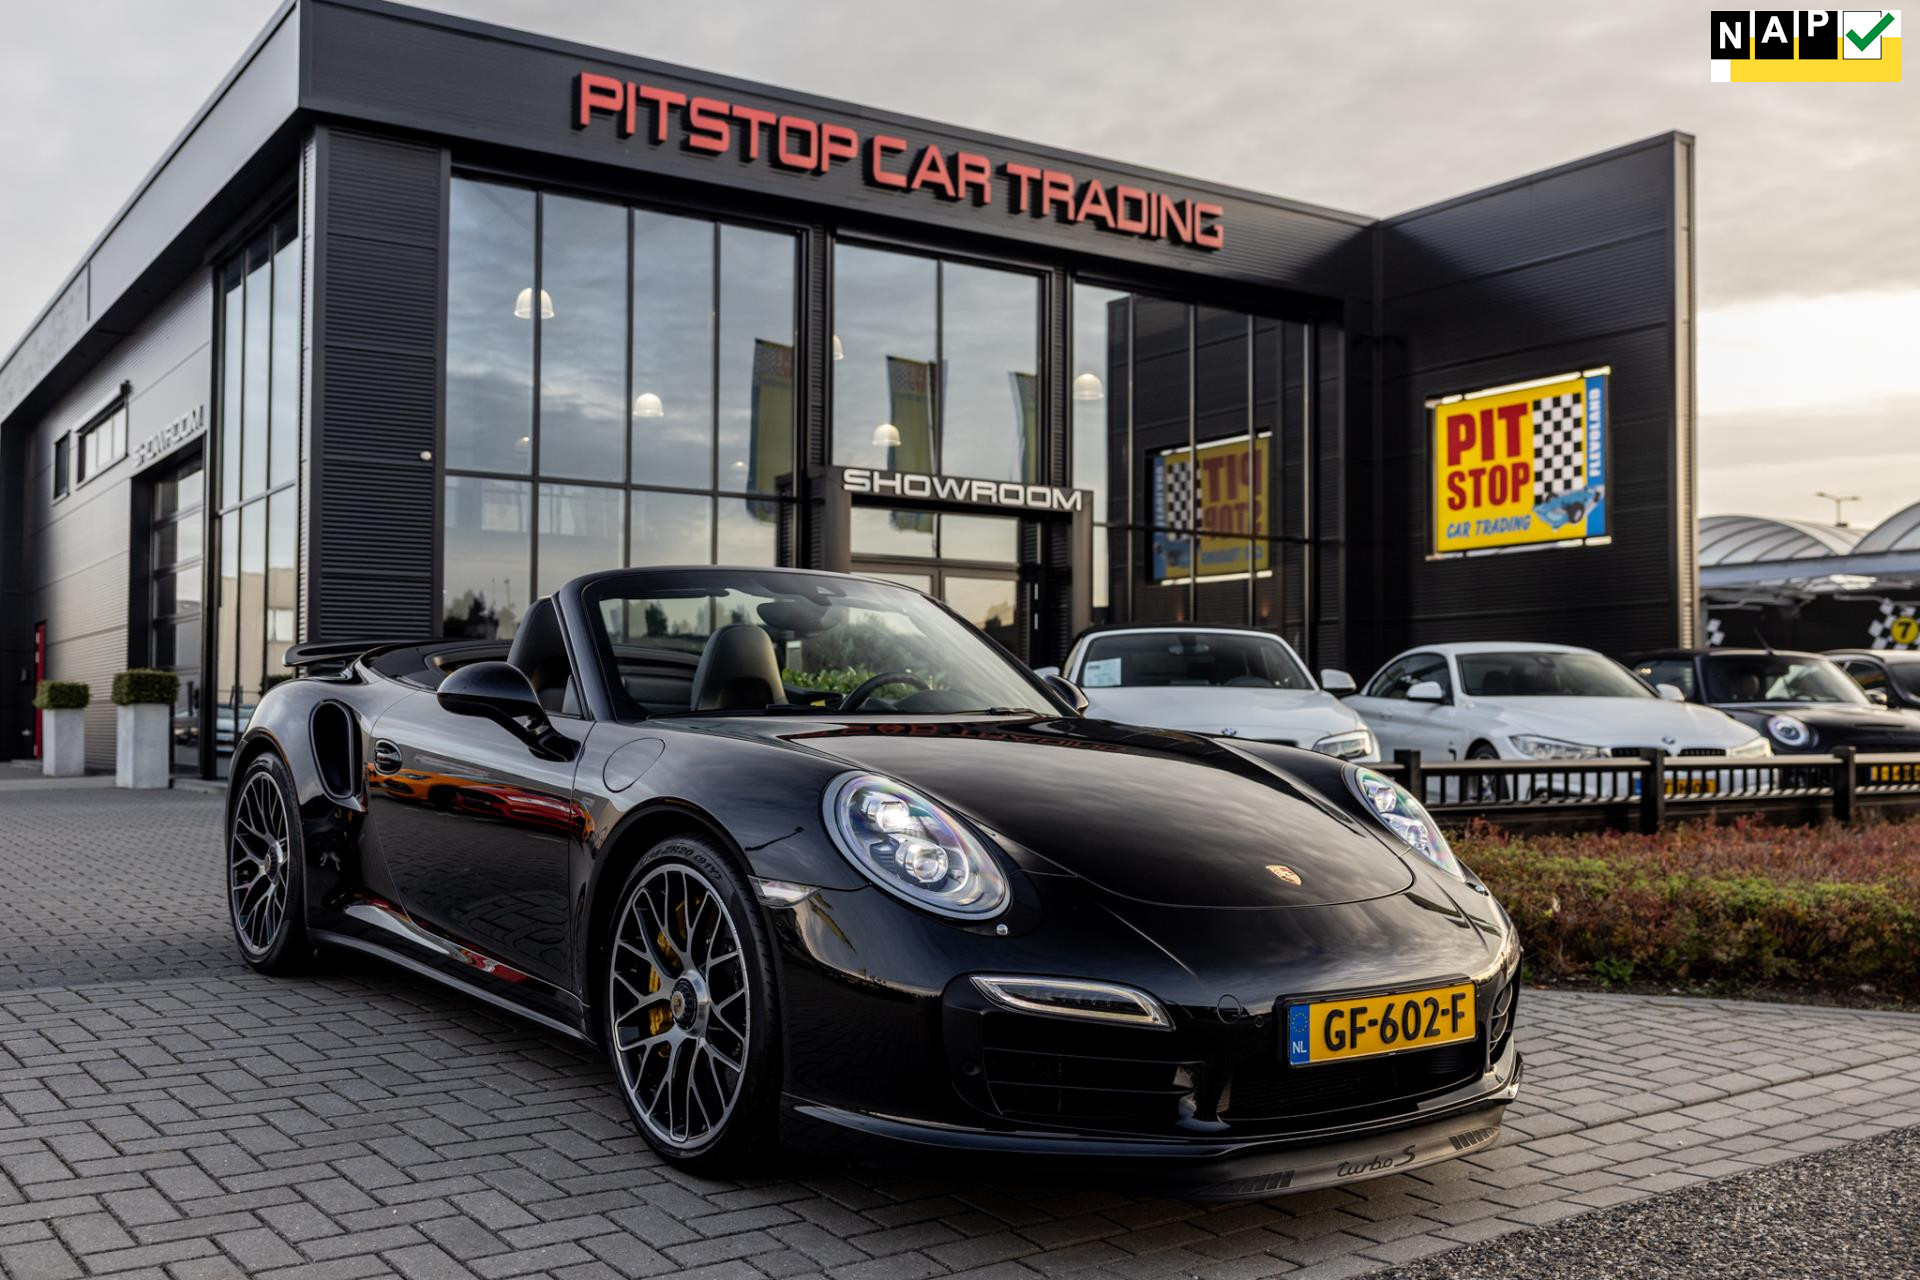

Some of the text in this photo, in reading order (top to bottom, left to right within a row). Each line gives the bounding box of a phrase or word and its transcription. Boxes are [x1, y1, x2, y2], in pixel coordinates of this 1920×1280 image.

[579, 72, 1224, 250] PITSTOP CAR TRADING
[1447, 402, 1528, 466] PIT
[1588, 388, 1601, 477] FLEVOLAND
[843, 468, 1082, 511] SHOWROOM
[1446, 462, 1530, 511] STOP
[1447, 514, 1531, 539] CAR TRADING
[1897, 621, 1912, 639] 7
[1323, 992, 1467, 1051] GF-602-F
[1292, 1040, 1307, 1054] NL
[1337, 1145, 1416, 1178] turbo S
